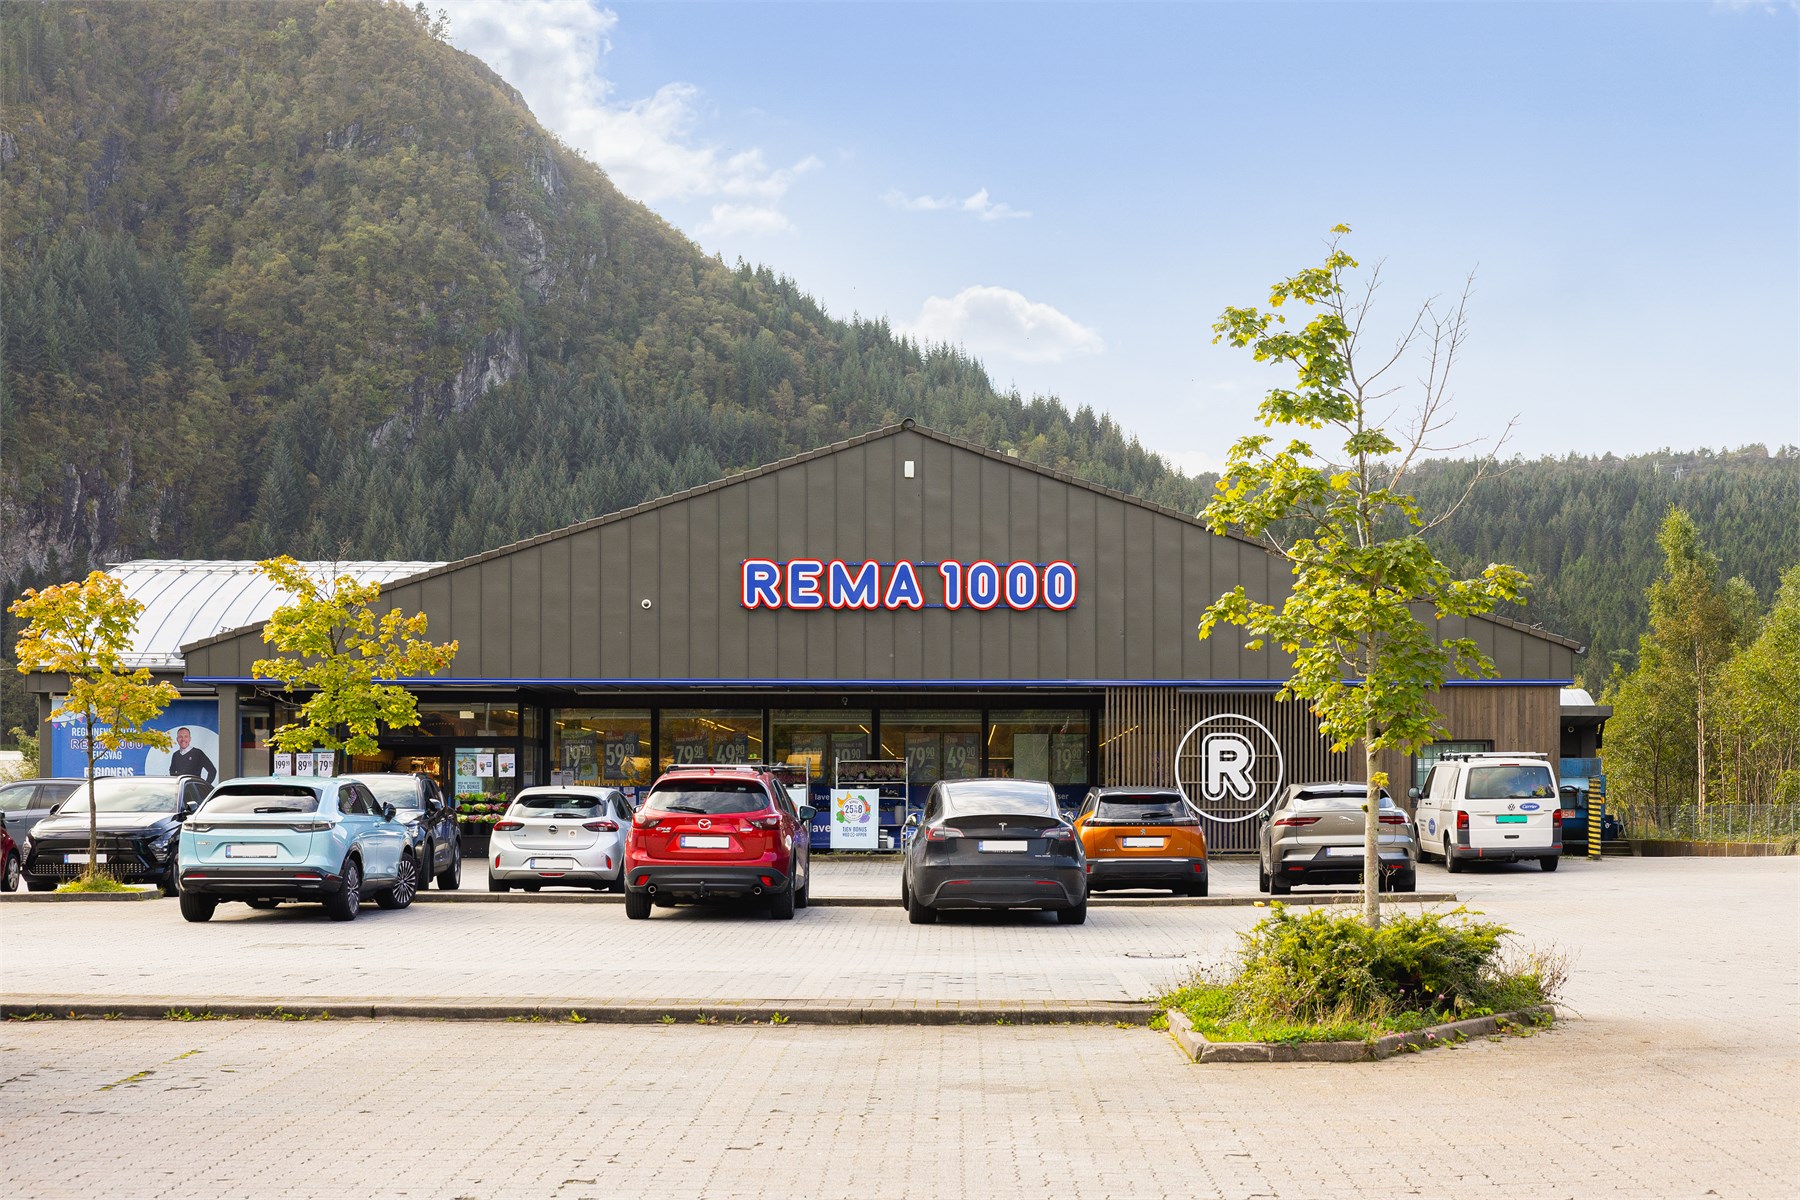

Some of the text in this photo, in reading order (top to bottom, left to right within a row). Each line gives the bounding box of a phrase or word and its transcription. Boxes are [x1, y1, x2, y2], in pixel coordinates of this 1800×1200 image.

[741, 558, 1078, 611] REMA 1000
[1202, 733, 1256, 801] R
